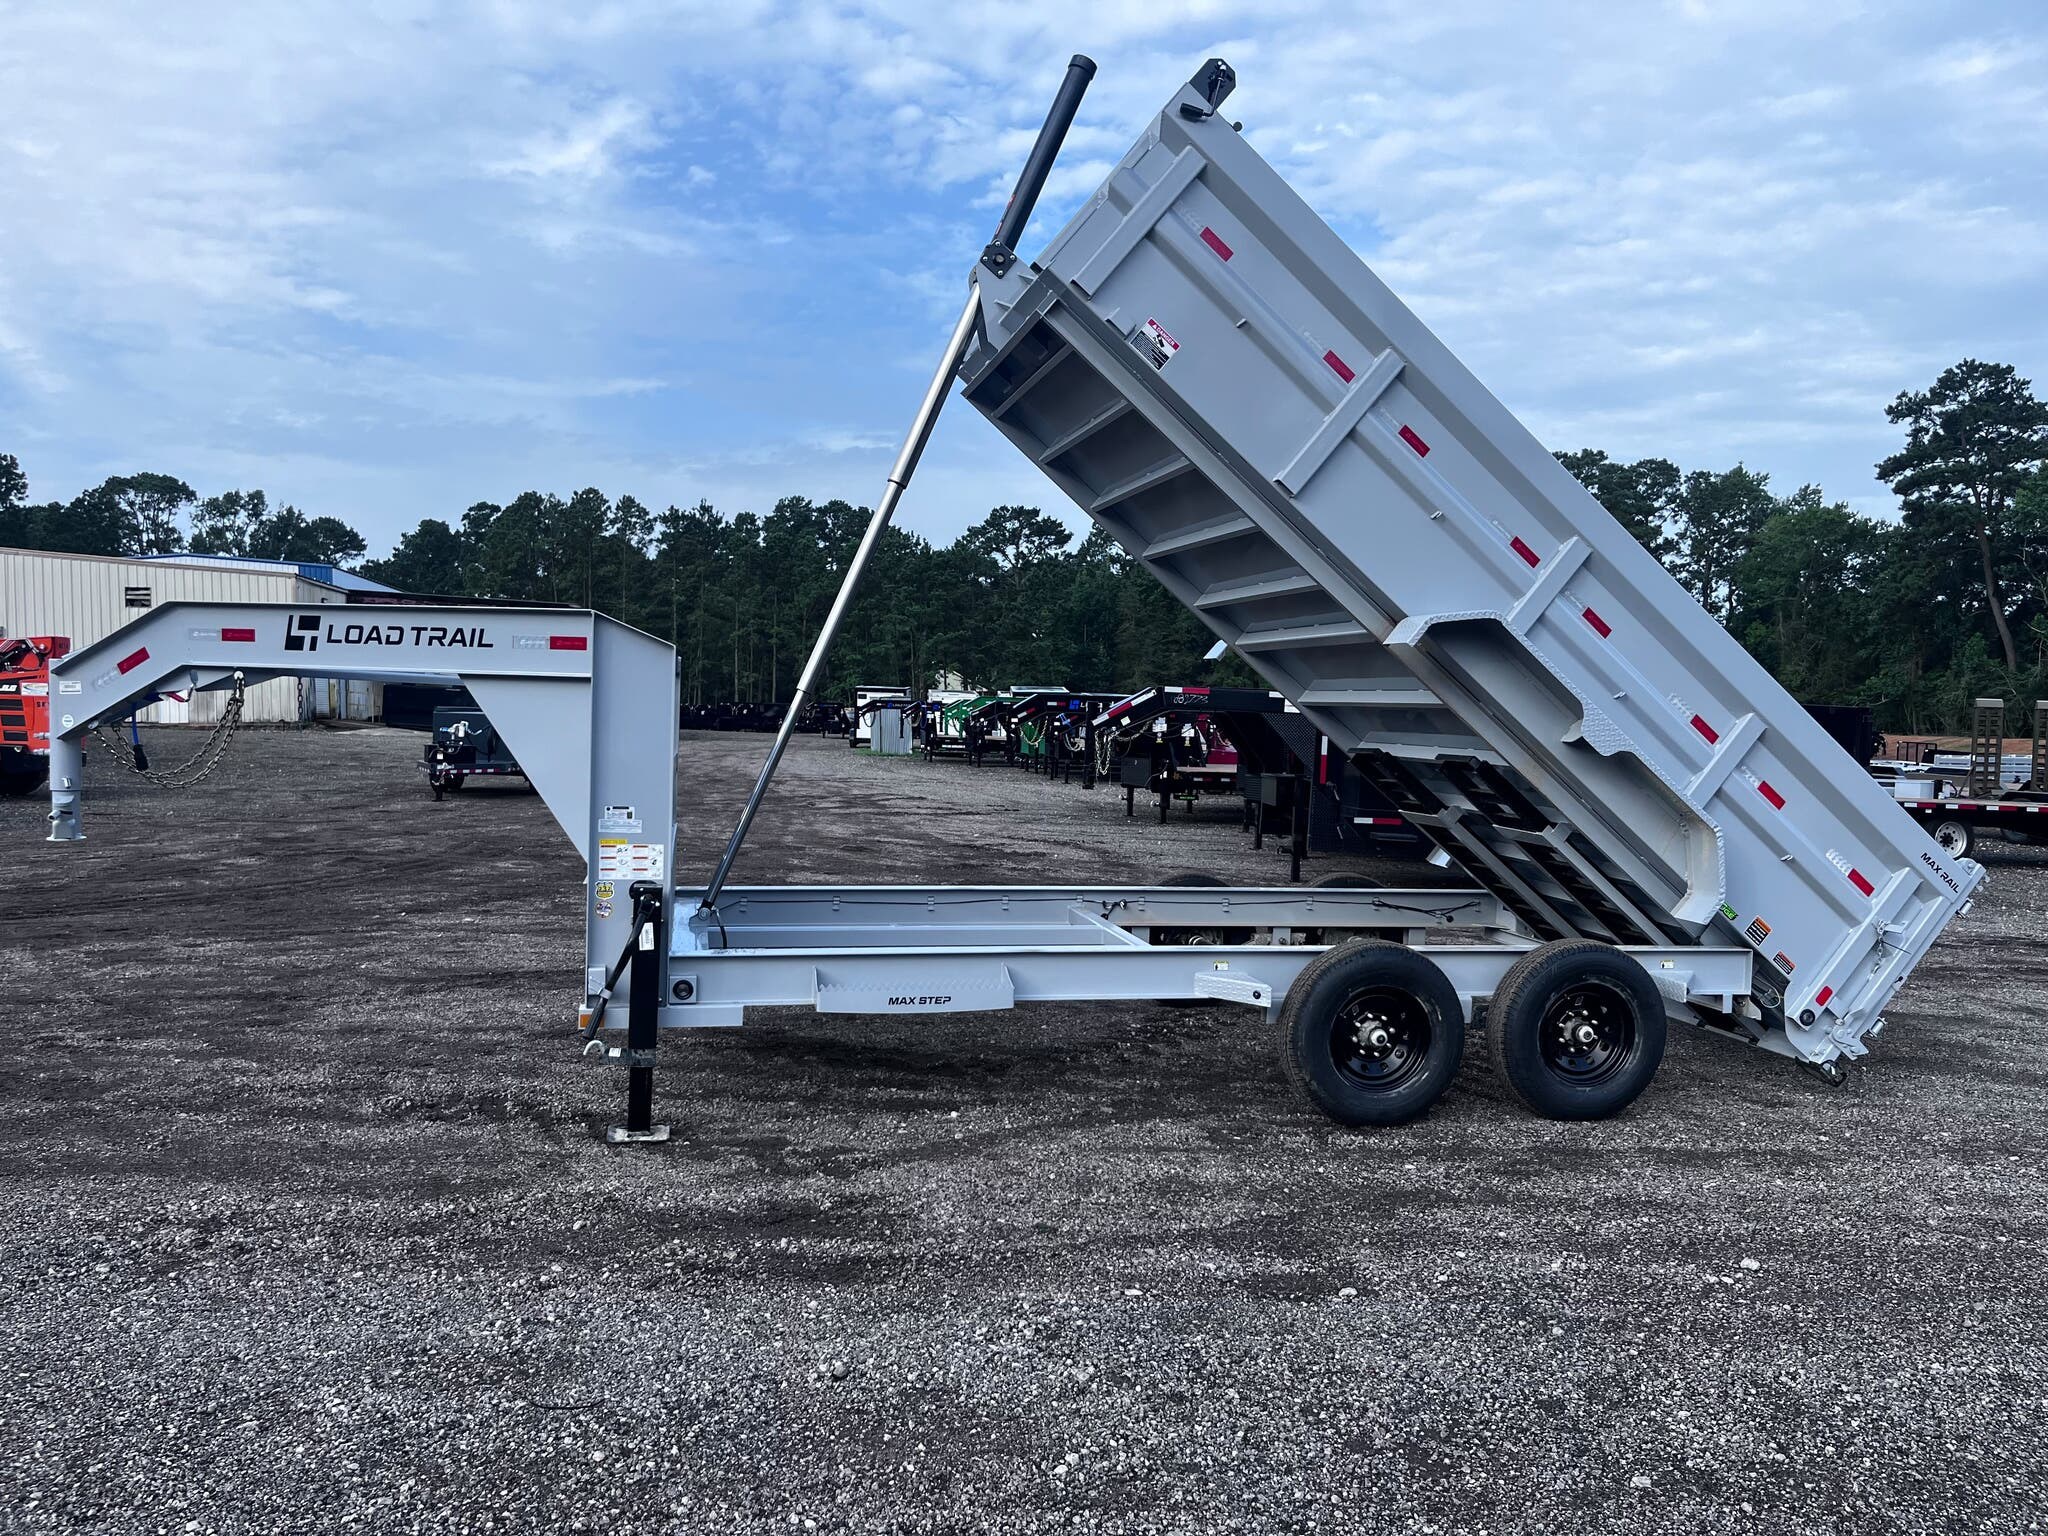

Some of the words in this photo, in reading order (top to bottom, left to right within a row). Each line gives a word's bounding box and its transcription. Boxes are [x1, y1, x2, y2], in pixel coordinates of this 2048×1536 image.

[1156, 326, 1175, 347] DANGER
[326, 624, 405, 646] LOAD
[410, 626, 494, 648] TRAIL
[1920, 852, 1942, 874] MAX
[1940, 871, 1959, 894] RAIL
[888, 996, 916, 1006] MAX
[918, 996, 952, 1005] STEP
